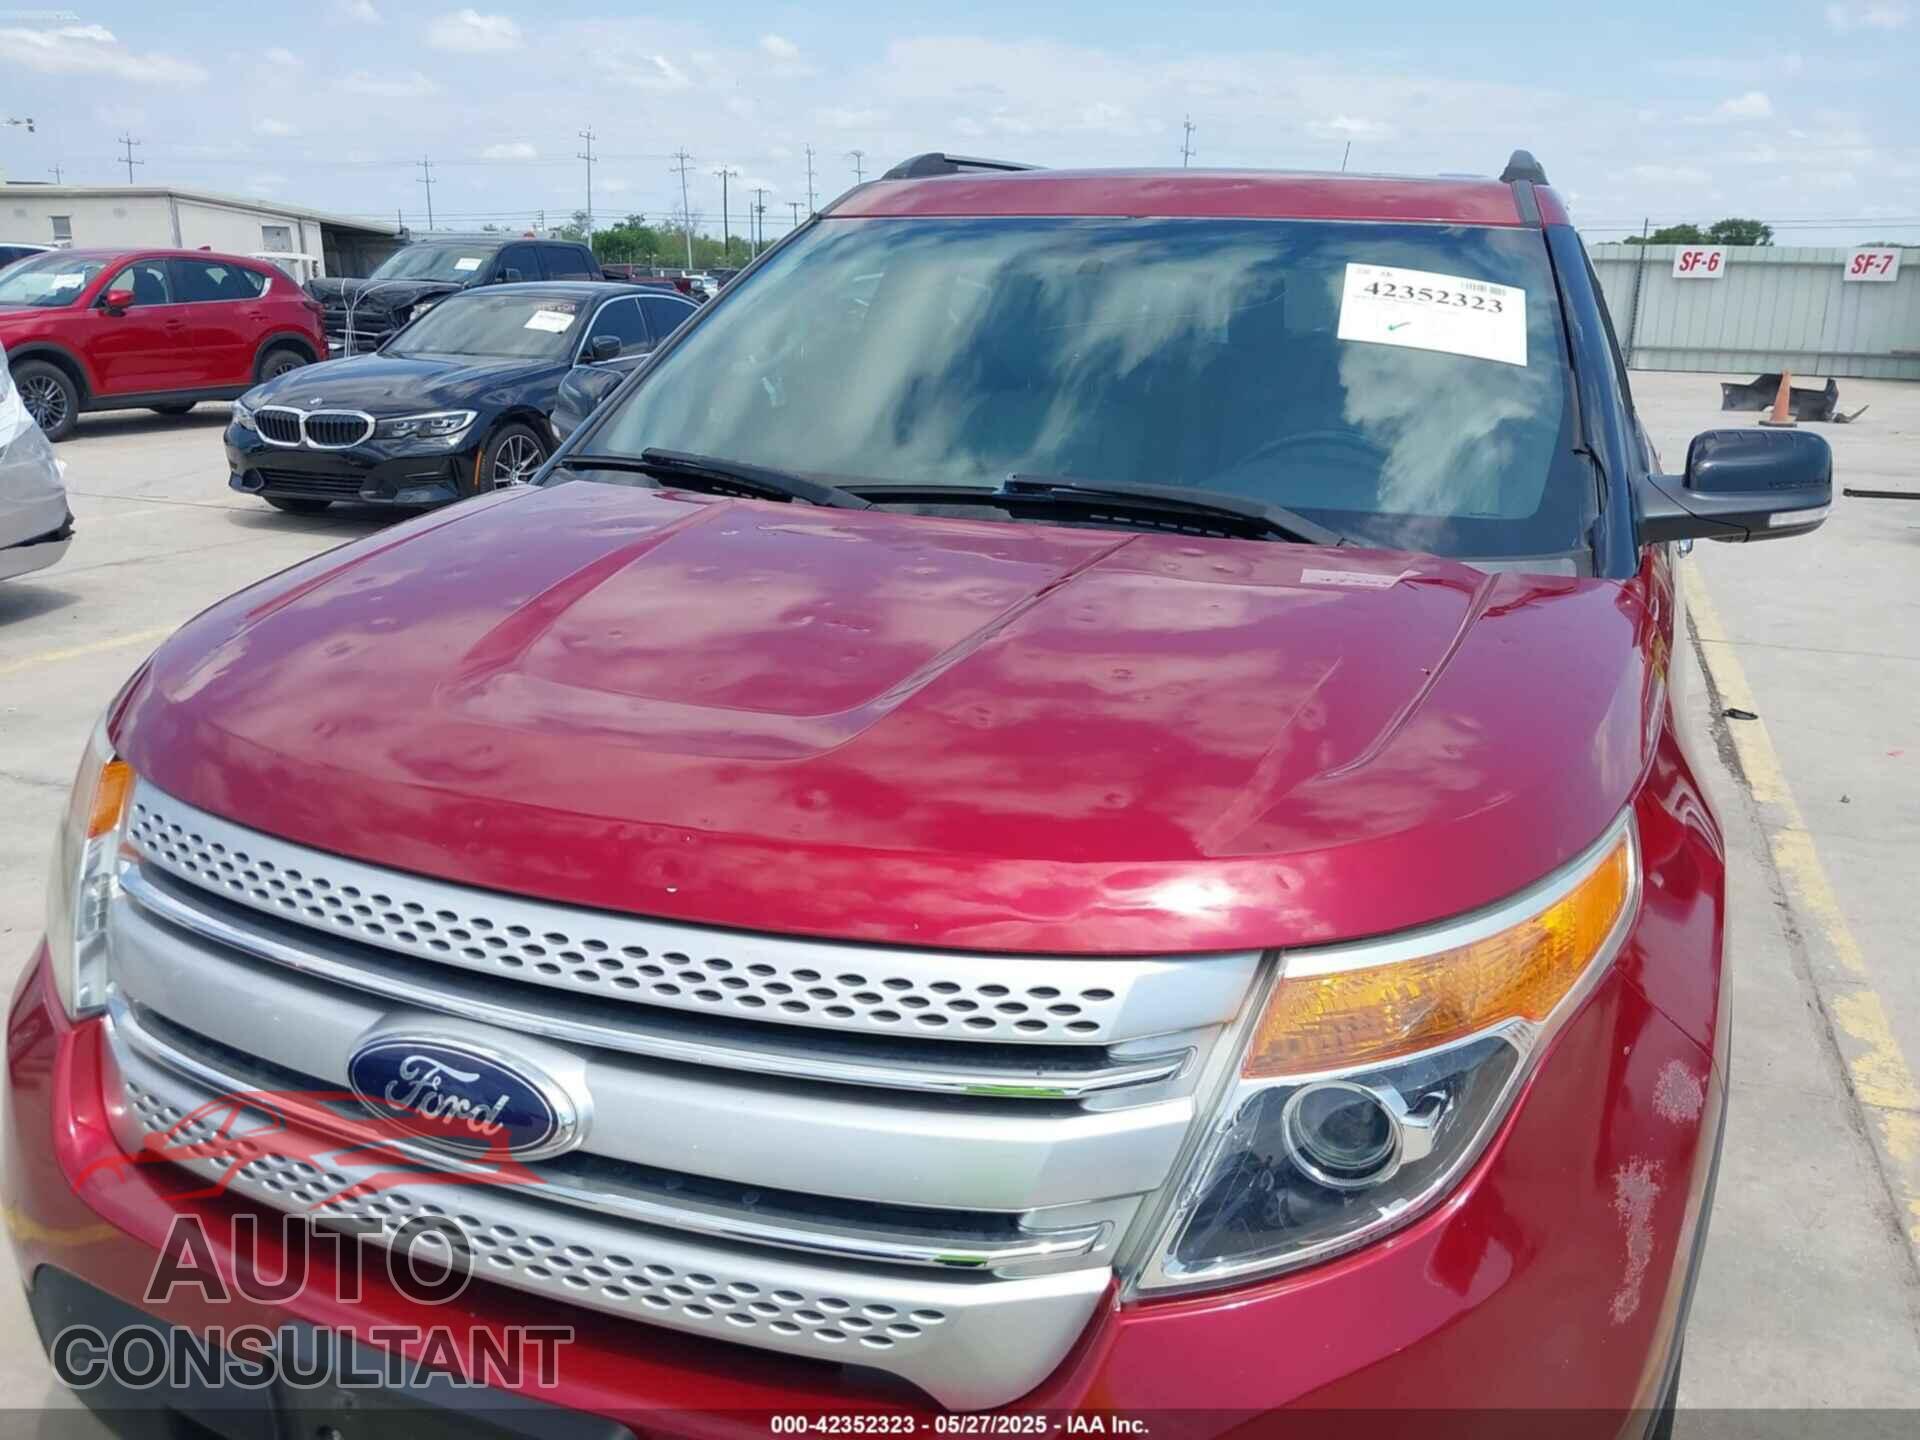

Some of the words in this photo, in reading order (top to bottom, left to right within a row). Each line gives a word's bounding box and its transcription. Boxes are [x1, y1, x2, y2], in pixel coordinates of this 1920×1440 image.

[1679, 252, 1721, 271] SF-6
[1851, 254, 1893, 274] SF-7
[1363, 281, 1504, 314] 42352323
[384, 1055, 510, 1136] Ford
